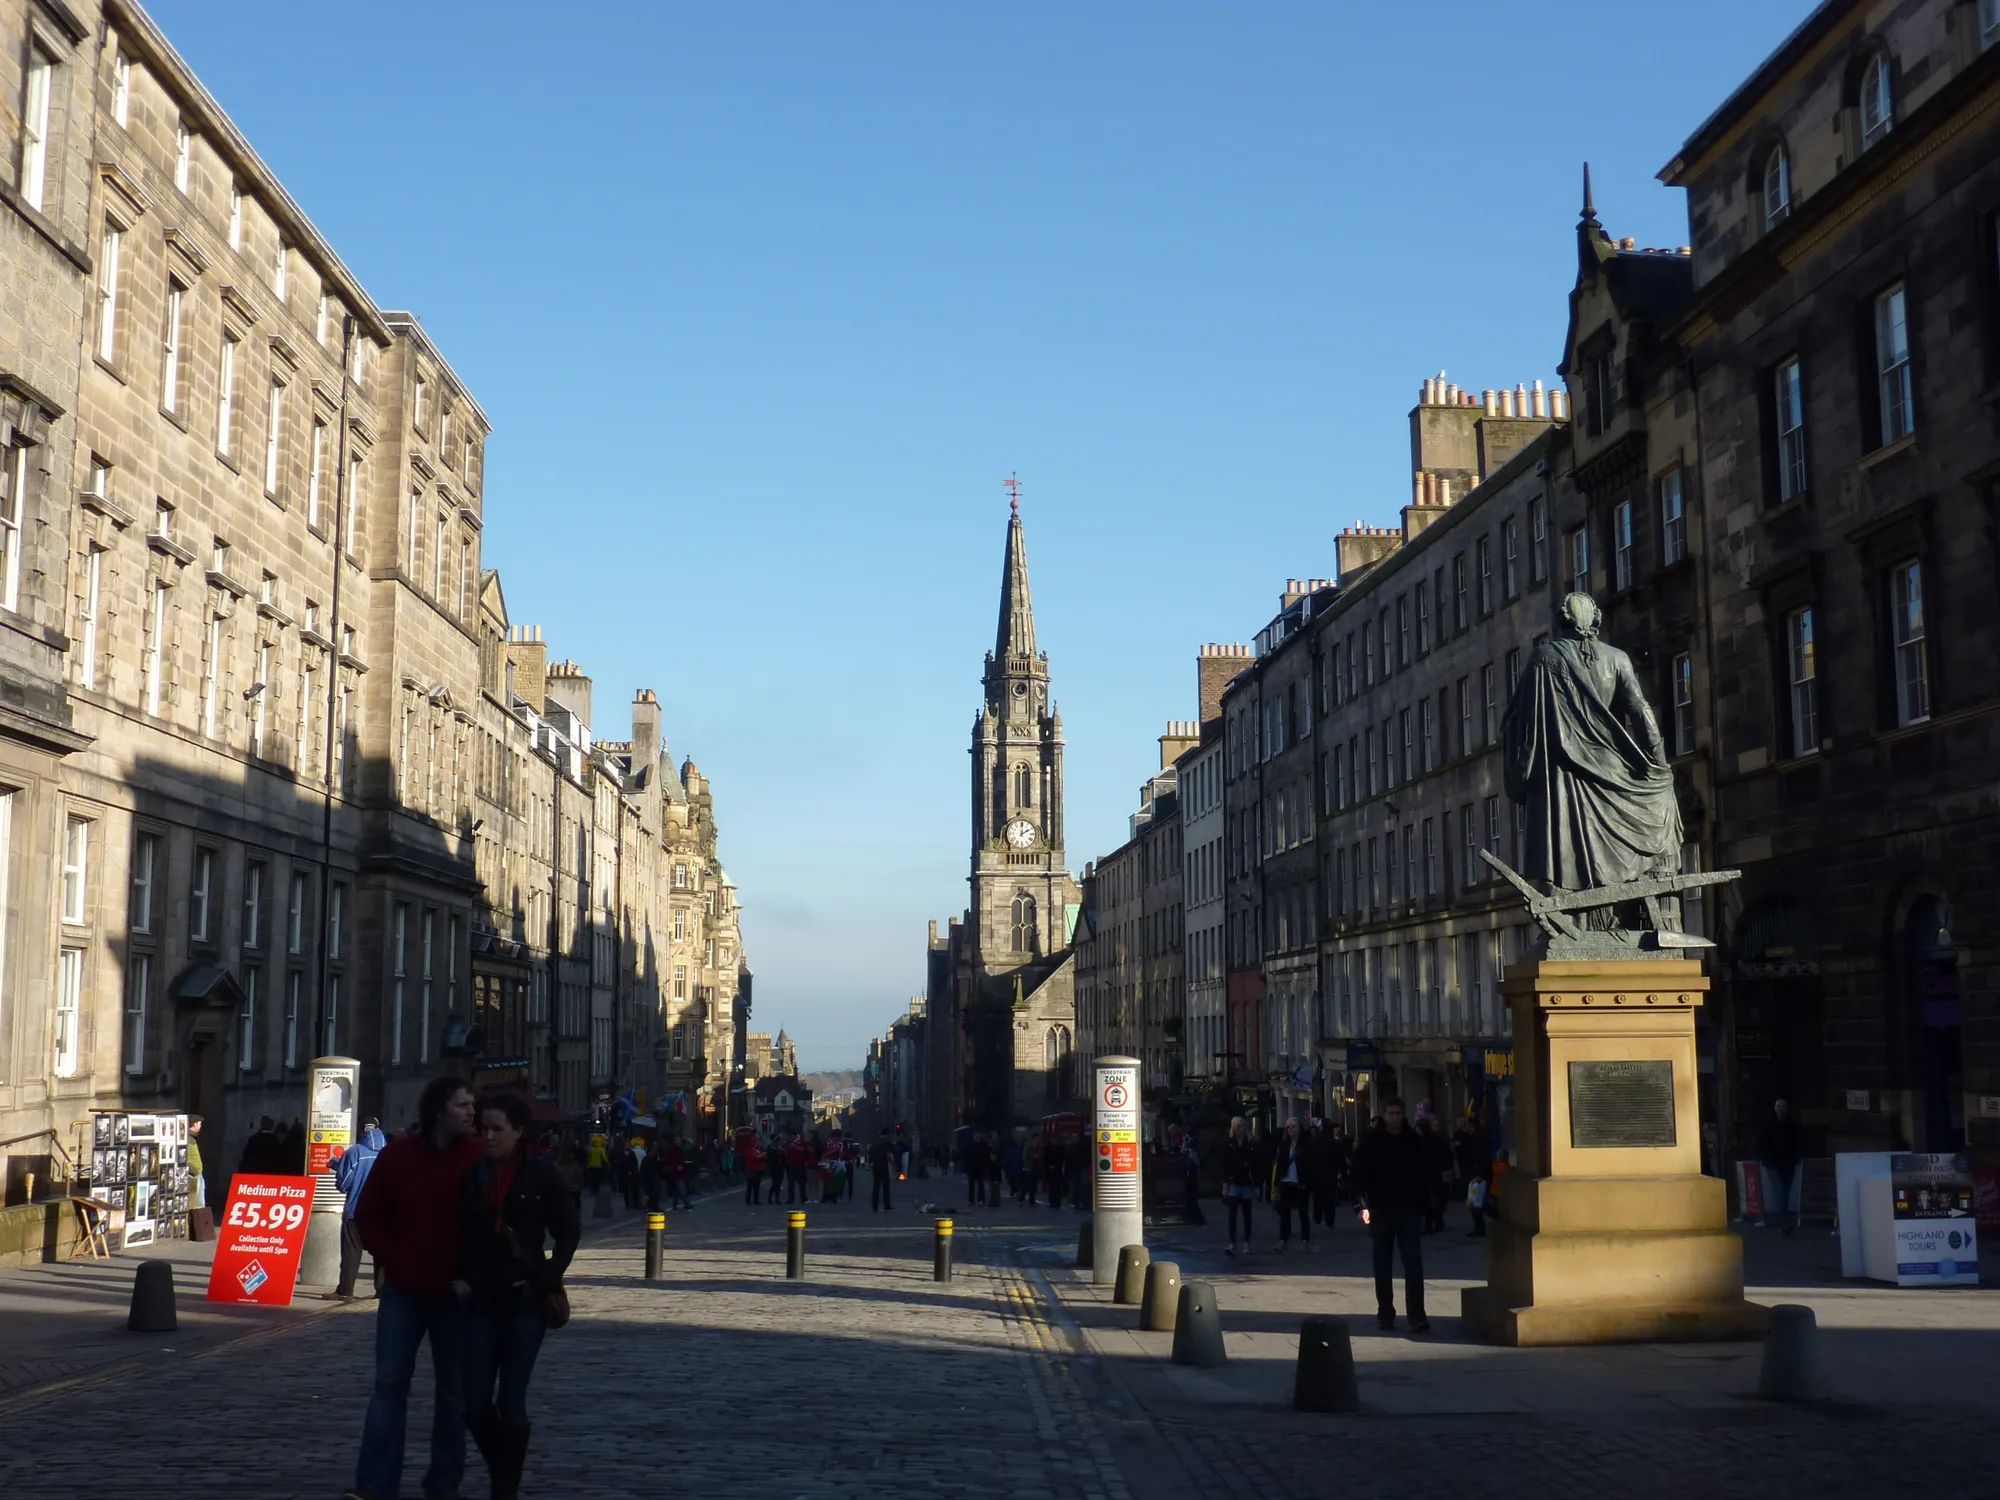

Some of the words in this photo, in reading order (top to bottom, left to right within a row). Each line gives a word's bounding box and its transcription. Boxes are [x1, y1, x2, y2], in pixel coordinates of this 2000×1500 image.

[1484, 1048, 1507, 1081] fringe
[1104, 1075, 1127, 1083] ZONE
[237, 1184, 277, 1196] Medium
[279, 1185, 306, 1198] Pizza
[228, 1201, 304, 1231] £5.99
[238, 1234, 269, 1244] Collection
[269, 1236, 285, 1246] Only
[1897, 1230, 1945, 1240] HIGHLAND
[229, 1244, 258, 1253] Available
[258, 1245, 274, 1254] until
[273, 1247, 289, 1255] 5pm
[1907, 1242, 1937, 1251] TOURS
